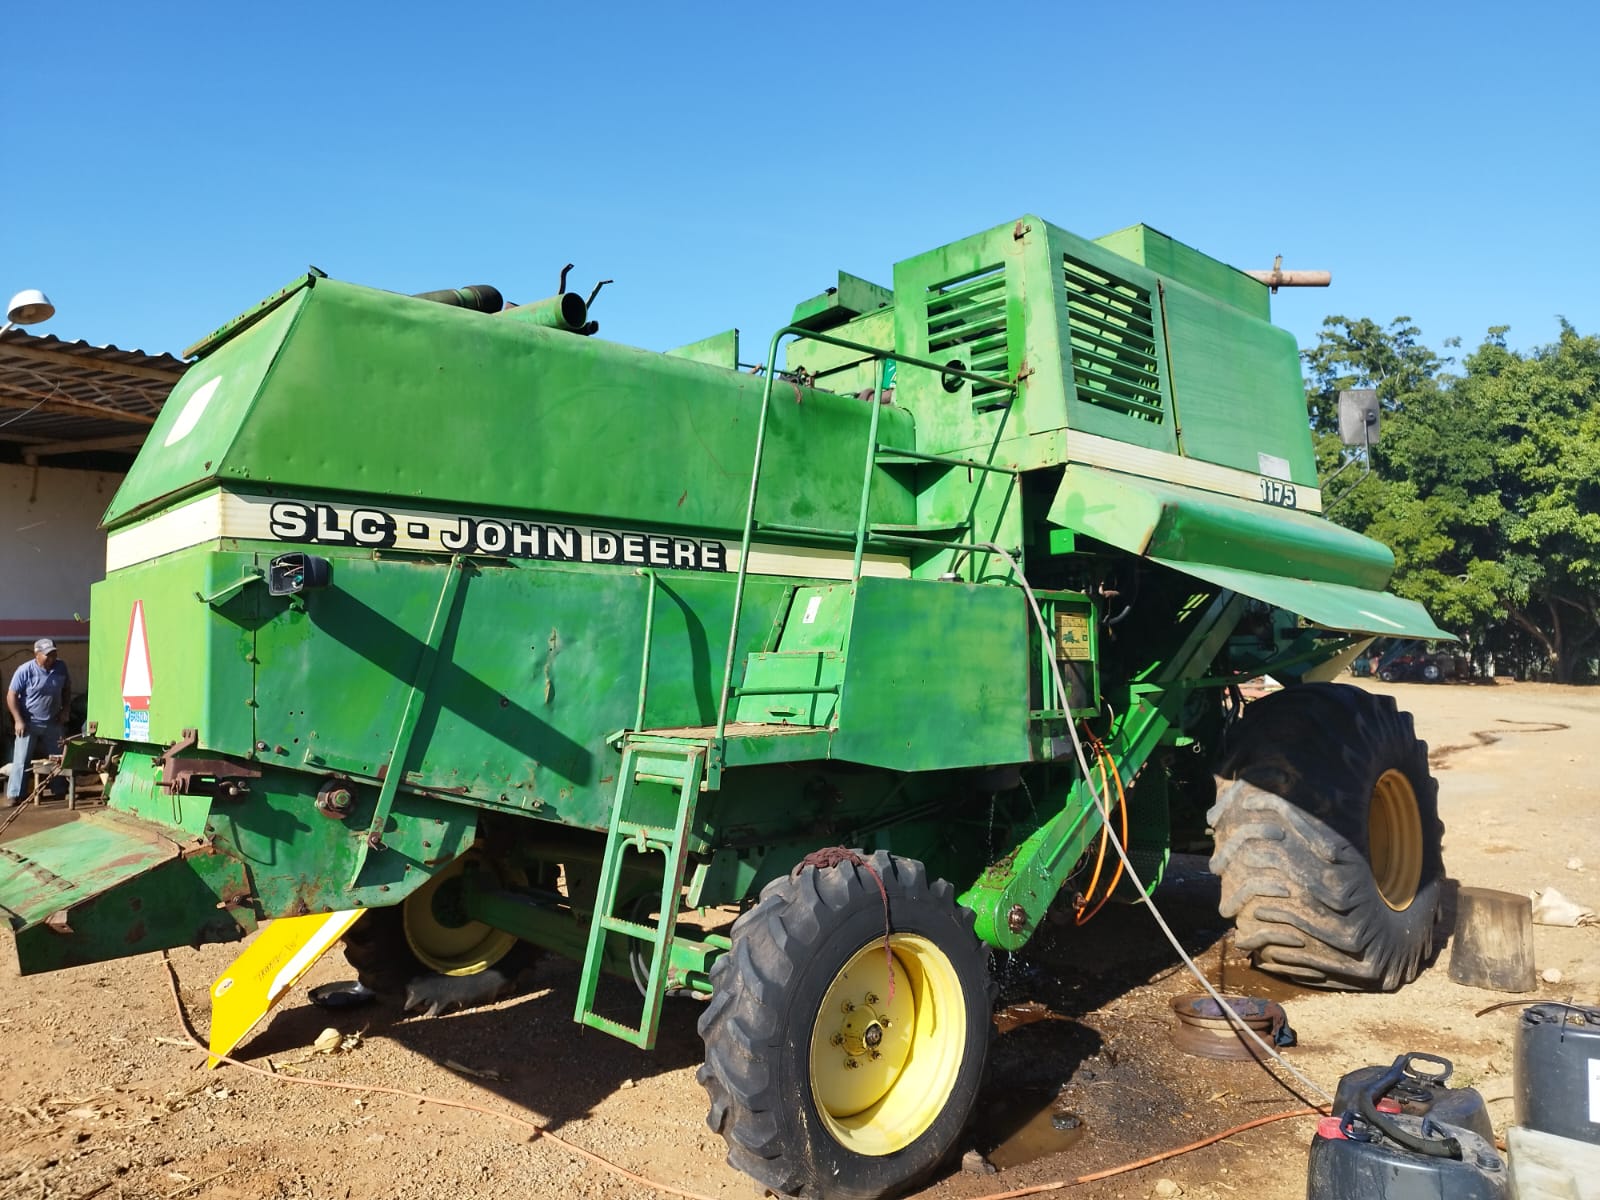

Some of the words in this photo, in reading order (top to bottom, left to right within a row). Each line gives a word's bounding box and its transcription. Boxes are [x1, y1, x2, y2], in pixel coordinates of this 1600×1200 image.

[1260, 479, 1297, 508] 1175
[270, 502, 397, 548] SLC
[440, 518, 582, 563] JOHN
[591, 530, 727, 573] DEERE
